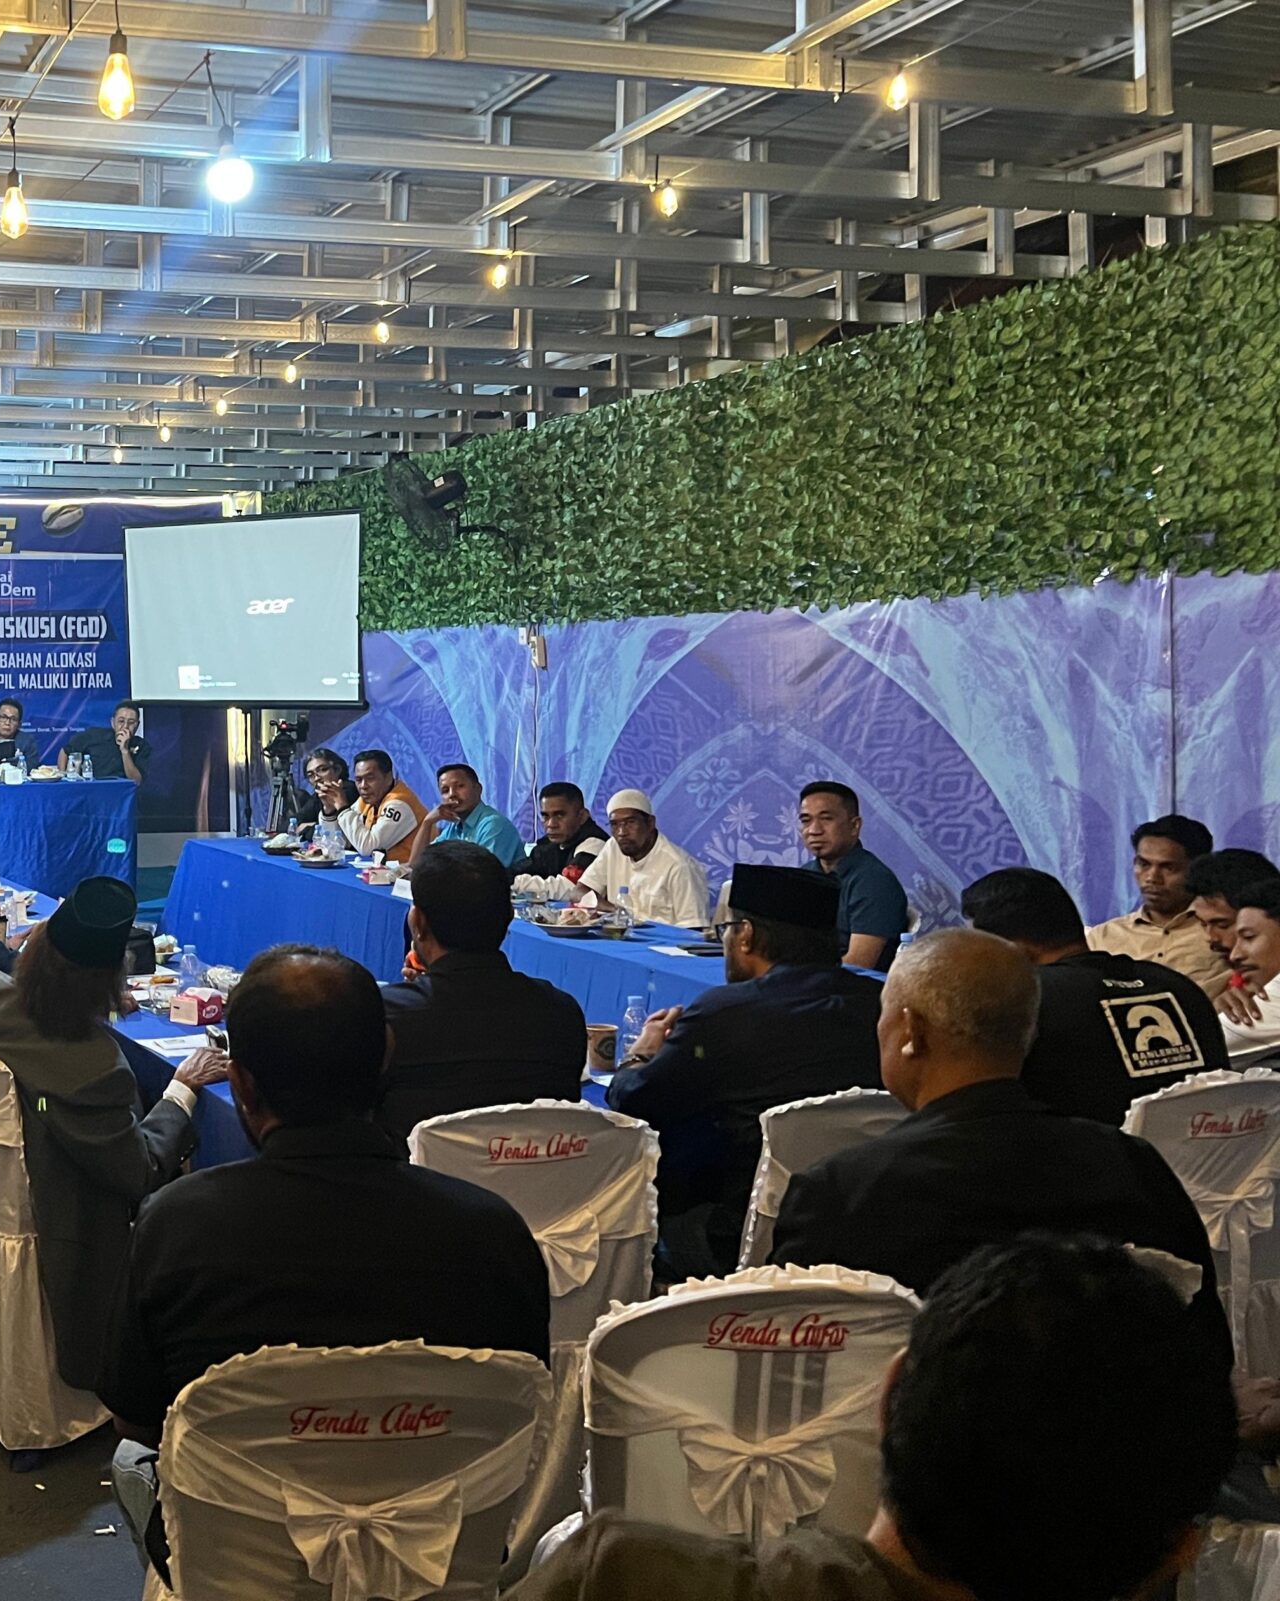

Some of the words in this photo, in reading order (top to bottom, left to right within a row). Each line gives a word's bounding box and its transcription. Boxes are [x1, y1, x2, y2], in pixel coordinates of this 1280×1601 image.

[246, 598, 295, 615] acer
[60, 615, 108, 639] (FGD)
[45, 652, 96, 668] ALOKASI
[20, 673, 68, 689] MALUKU
[73, 672, 112, 688] UTARA
[1191, 1111, 1234, 1136] Tenda
[488, 1136, 539, 1161] Tenda
[546, 1132, 589, 1158] Aufar
[707, 1312, 781, 1346] Tenda
[290, 1406, 370, 1435] Tenda
[380, 1402, 453, 1436] Aufar
